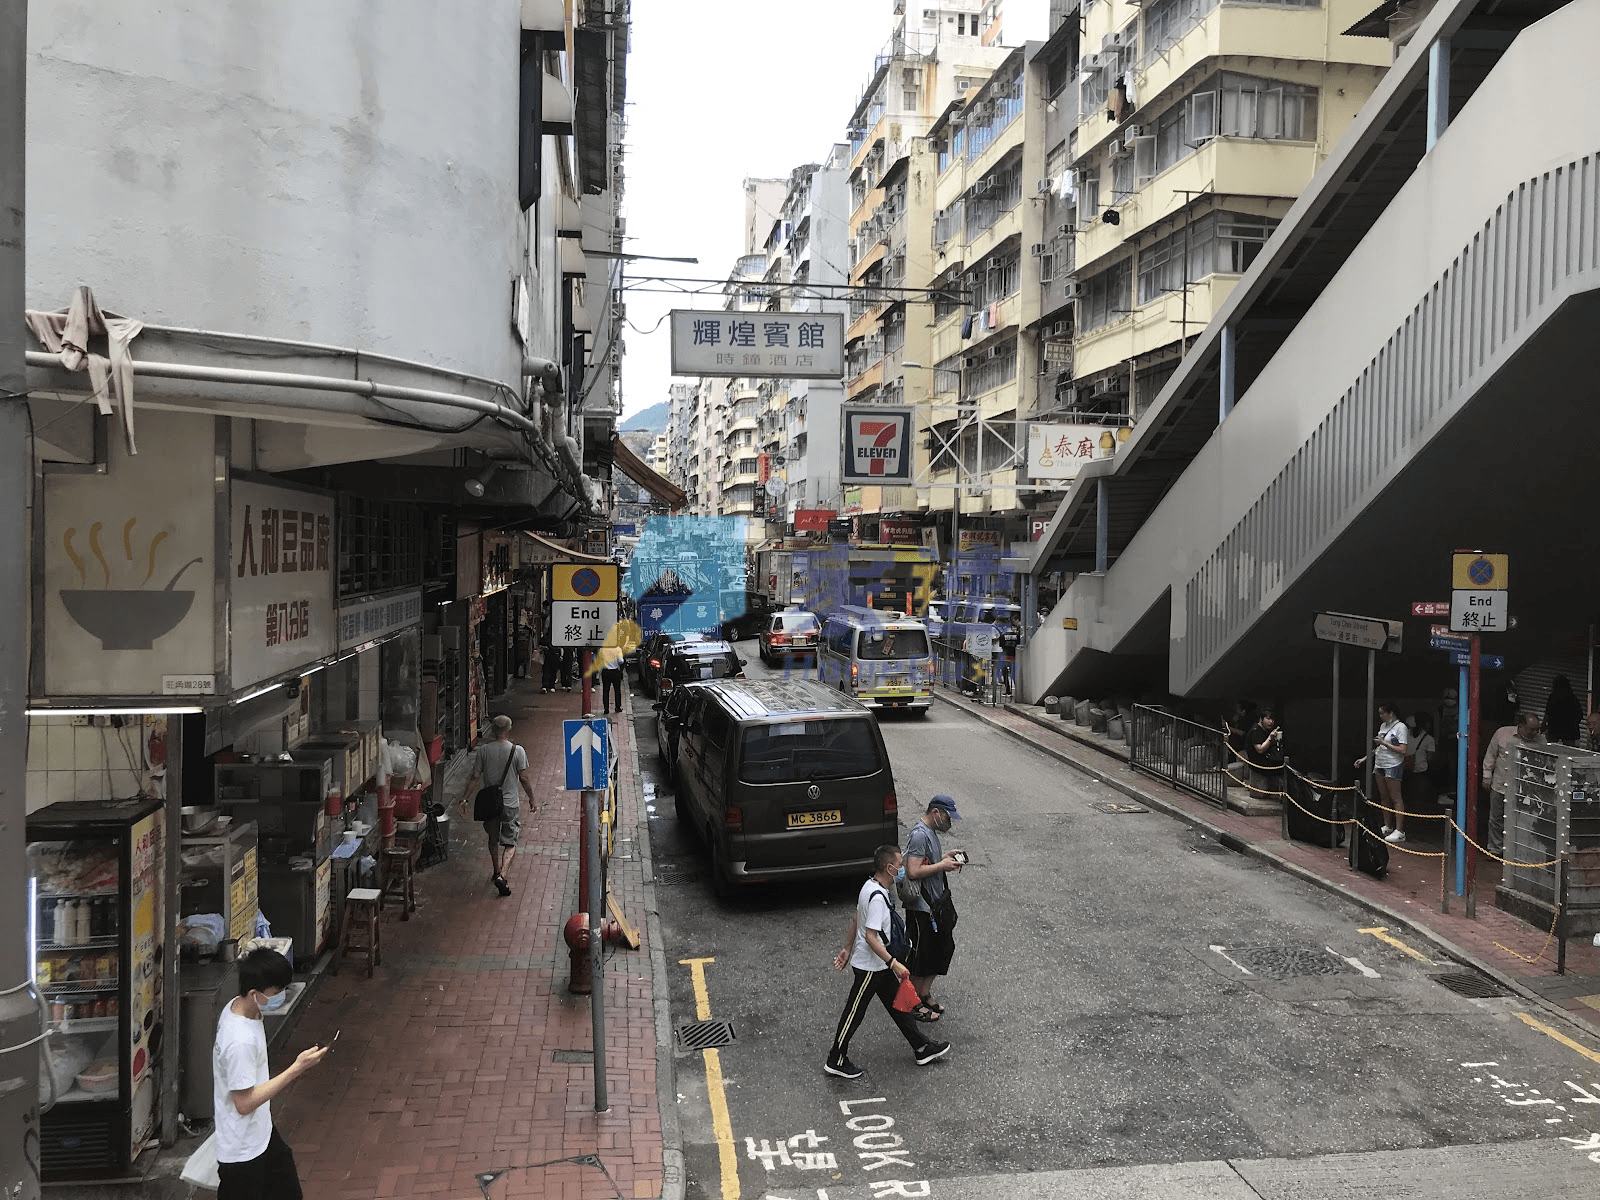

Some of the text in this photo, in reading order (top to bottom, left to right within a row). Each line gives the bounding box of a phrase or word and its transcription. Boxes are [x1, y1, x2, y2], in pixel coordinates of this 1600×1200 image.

[693, 319, 825, 349] 輝煌賓館
[716, 352, 813, 367] 時鐘酒店
[859, 421, 897, 475] 7
[1054, 434, 1095, 459] 泰廚
[1056, 459, 1072, 467] Thai
[238, 504, 330, 578] 人和豆品廠
[1469, 596, 1492, 606] End
[570, 606, 600, 620] End
[1462, 611, 1496, 628] 終止
[266, 600, 309, 647] 第八分店
[1330, 617, 1369, 631] Tung Choi Street
[564, 624, 605, 642] 終止
[1337, 631, 1358, 643] 通菜街
[166, 680, 212, 689] 旺角道28號
[791, 811, 838, 825] MC 3866
[839, 1097, 915, 1171] LOOK
